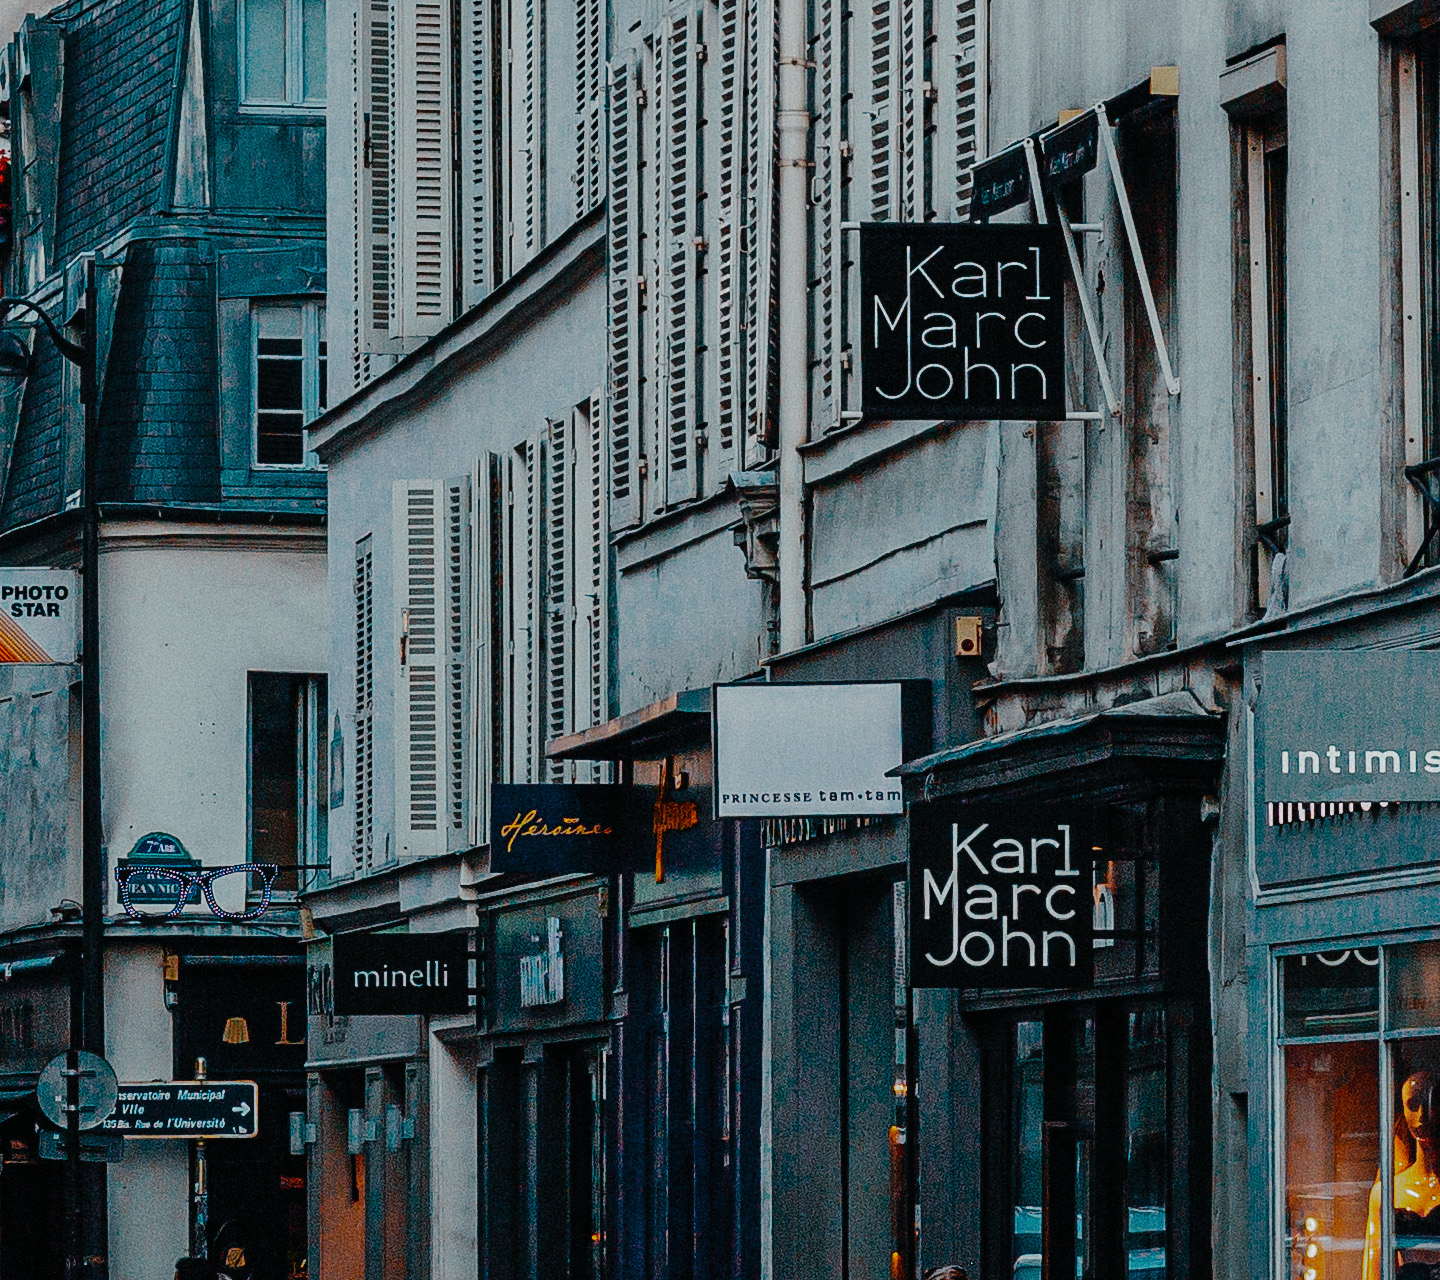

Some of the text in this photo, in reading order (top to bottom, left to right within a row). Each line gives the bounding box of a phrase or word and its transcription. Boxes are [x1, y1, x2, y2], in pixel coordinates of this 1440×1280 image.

[905, 245, 1051, 300] Karl
[874, 294, 1047, 349] Marc
[875, 346, 1047, 400] John
[1, 585, 69, 601] PHOTO
[10, 602, 60, 618] STAR
[722, 792, 813, 804] PRINCESSE
[951, 822, 1080, 876] Karl
[923, 868, 1076, 920] Marc
[924, 915, 1076, 967] John
[353, 961, 449, 988] minelli
[177, 1090, 226, 1102] Municipal
